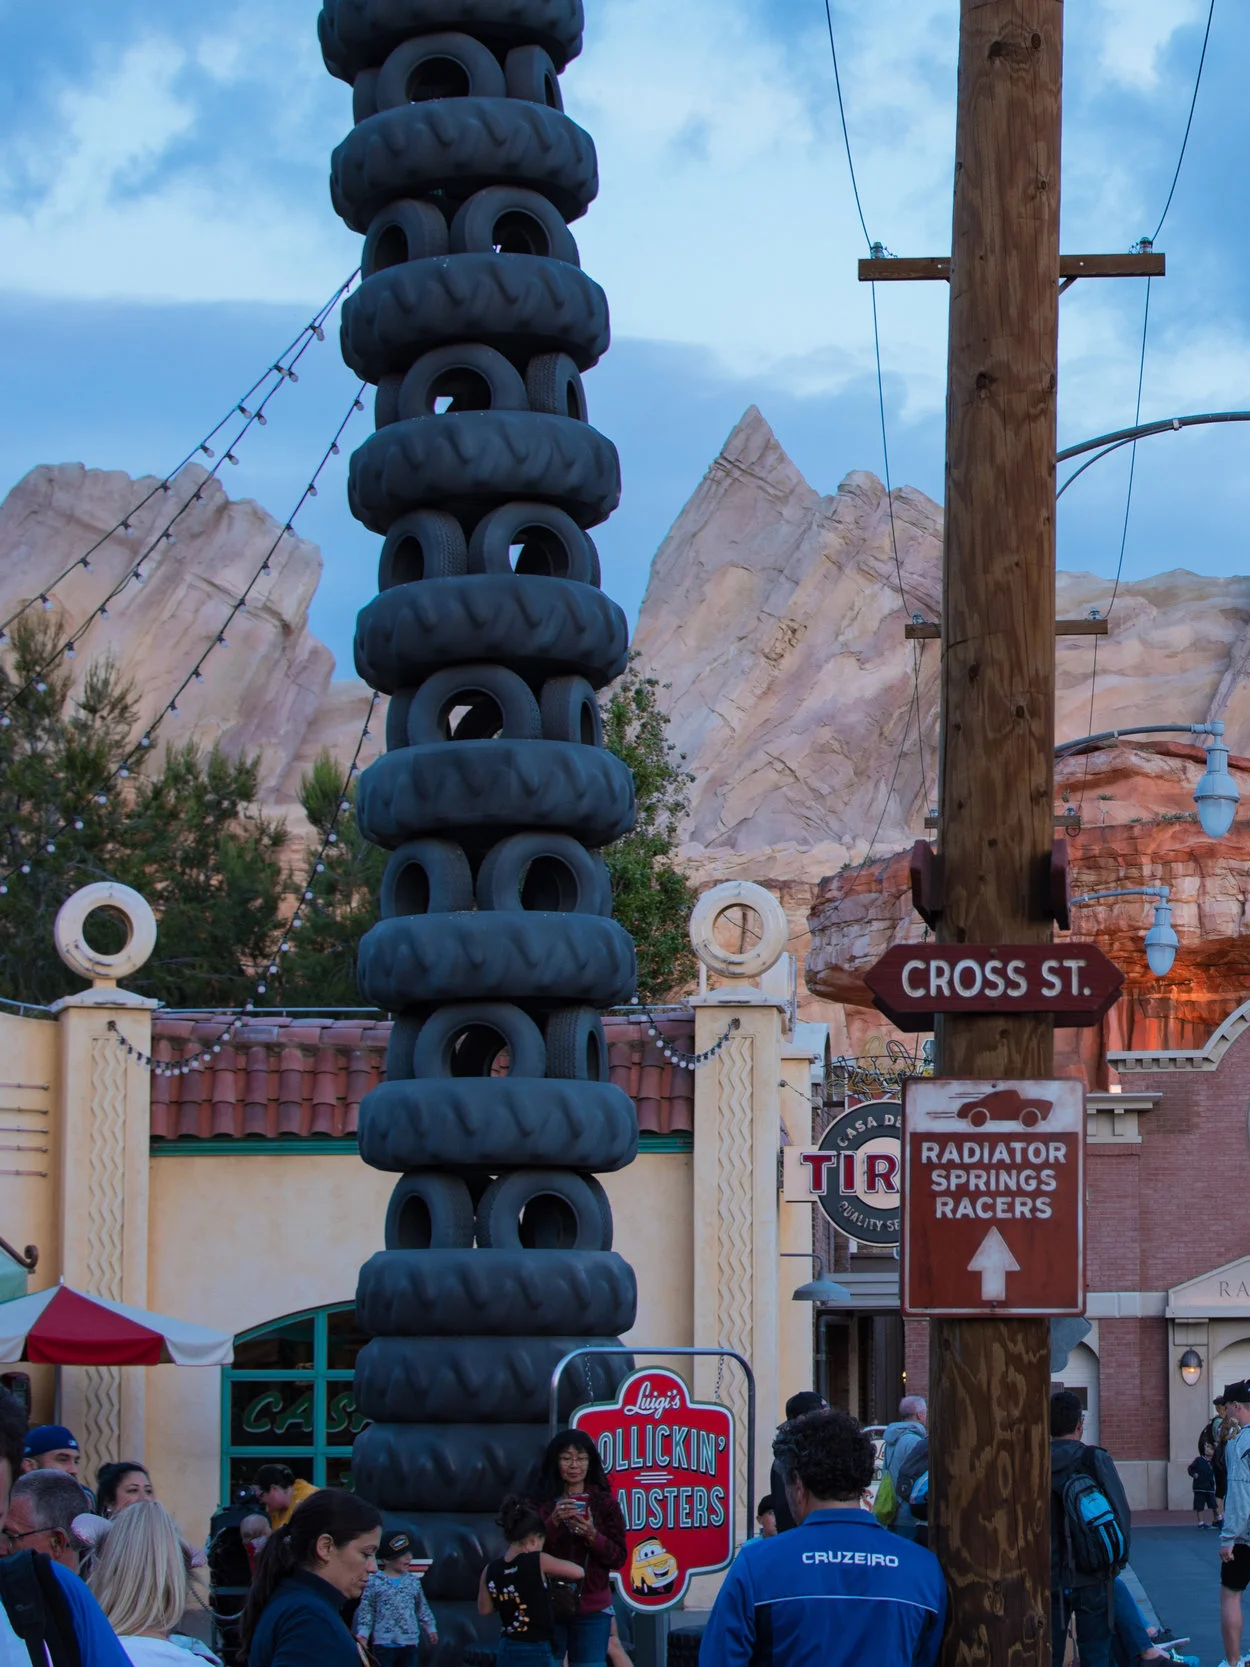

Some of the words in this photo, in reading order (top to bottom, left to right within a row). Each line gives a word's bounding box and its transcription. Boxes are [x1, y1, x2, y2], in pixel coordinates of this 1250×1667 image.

[902, 959, 1028, 997] CROSS
[1041, 959, 1093, 997] ST.
[837, 1116, 877, 1147] CASA
[921, 1142, 1067, 1164] RADIATOR
[931, 1169, 1057, 1192] SPRINGS
[936, 1197, 1052, 1219] RACERS
[624, 1381, 681, 1420] Luigi's
[801, 1550, 899, 1568] CRUZEIRO
